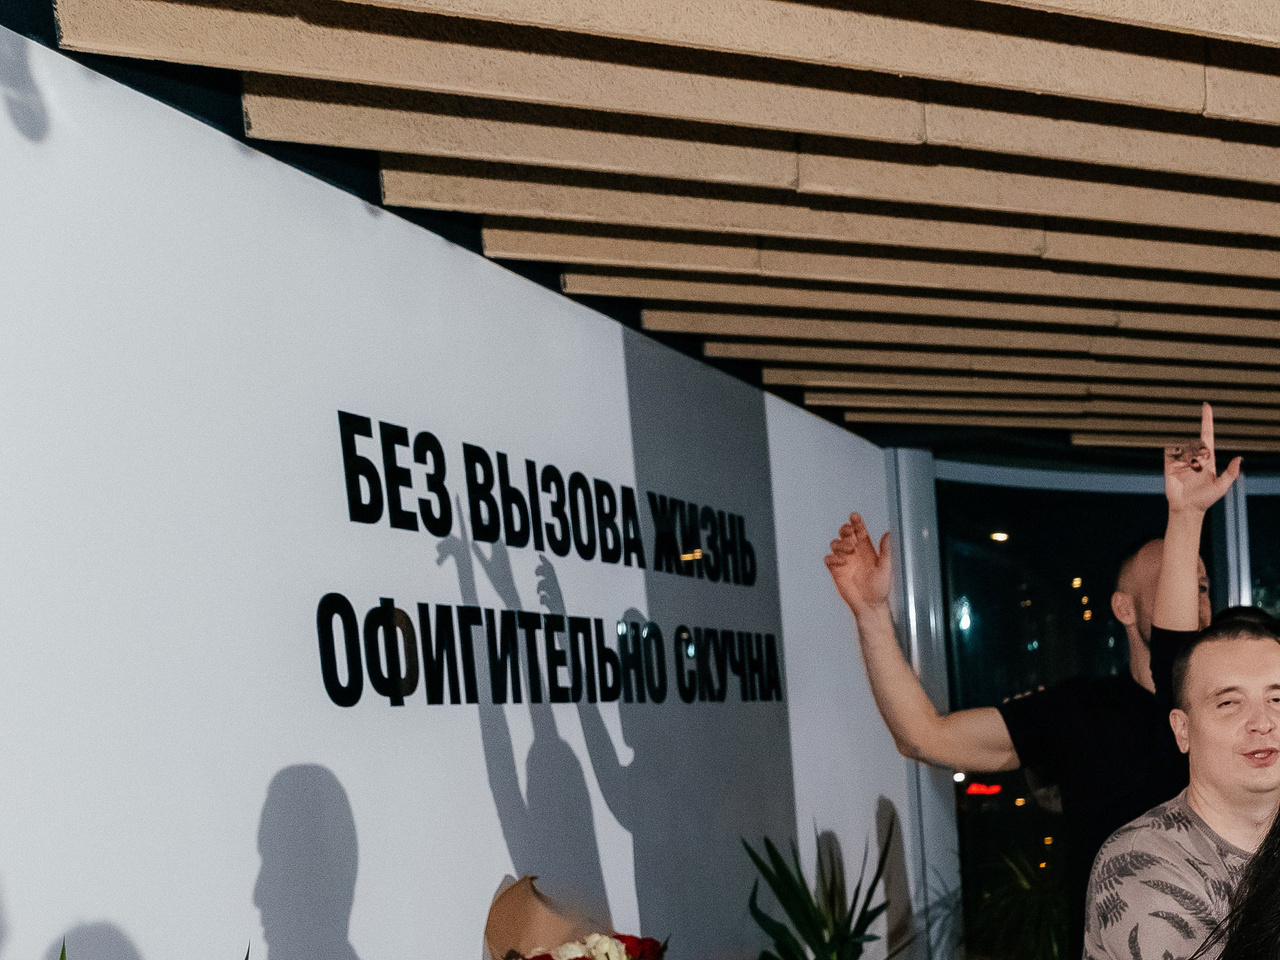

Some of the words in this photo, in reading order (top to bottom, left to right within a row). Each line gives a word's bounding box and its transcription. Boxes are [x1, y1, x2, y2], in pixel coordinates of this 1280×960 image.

[337, 410, 453, 538] БЕЗ
[462, 442, 646, 569] ВЫЗОВА
[647, 490, 757, 587] ЖИЗНЬ
[316, 592, 667, 708] ОФИГИТЕЛЬНО
[674, 624, 784, 702] СКУЧНА
